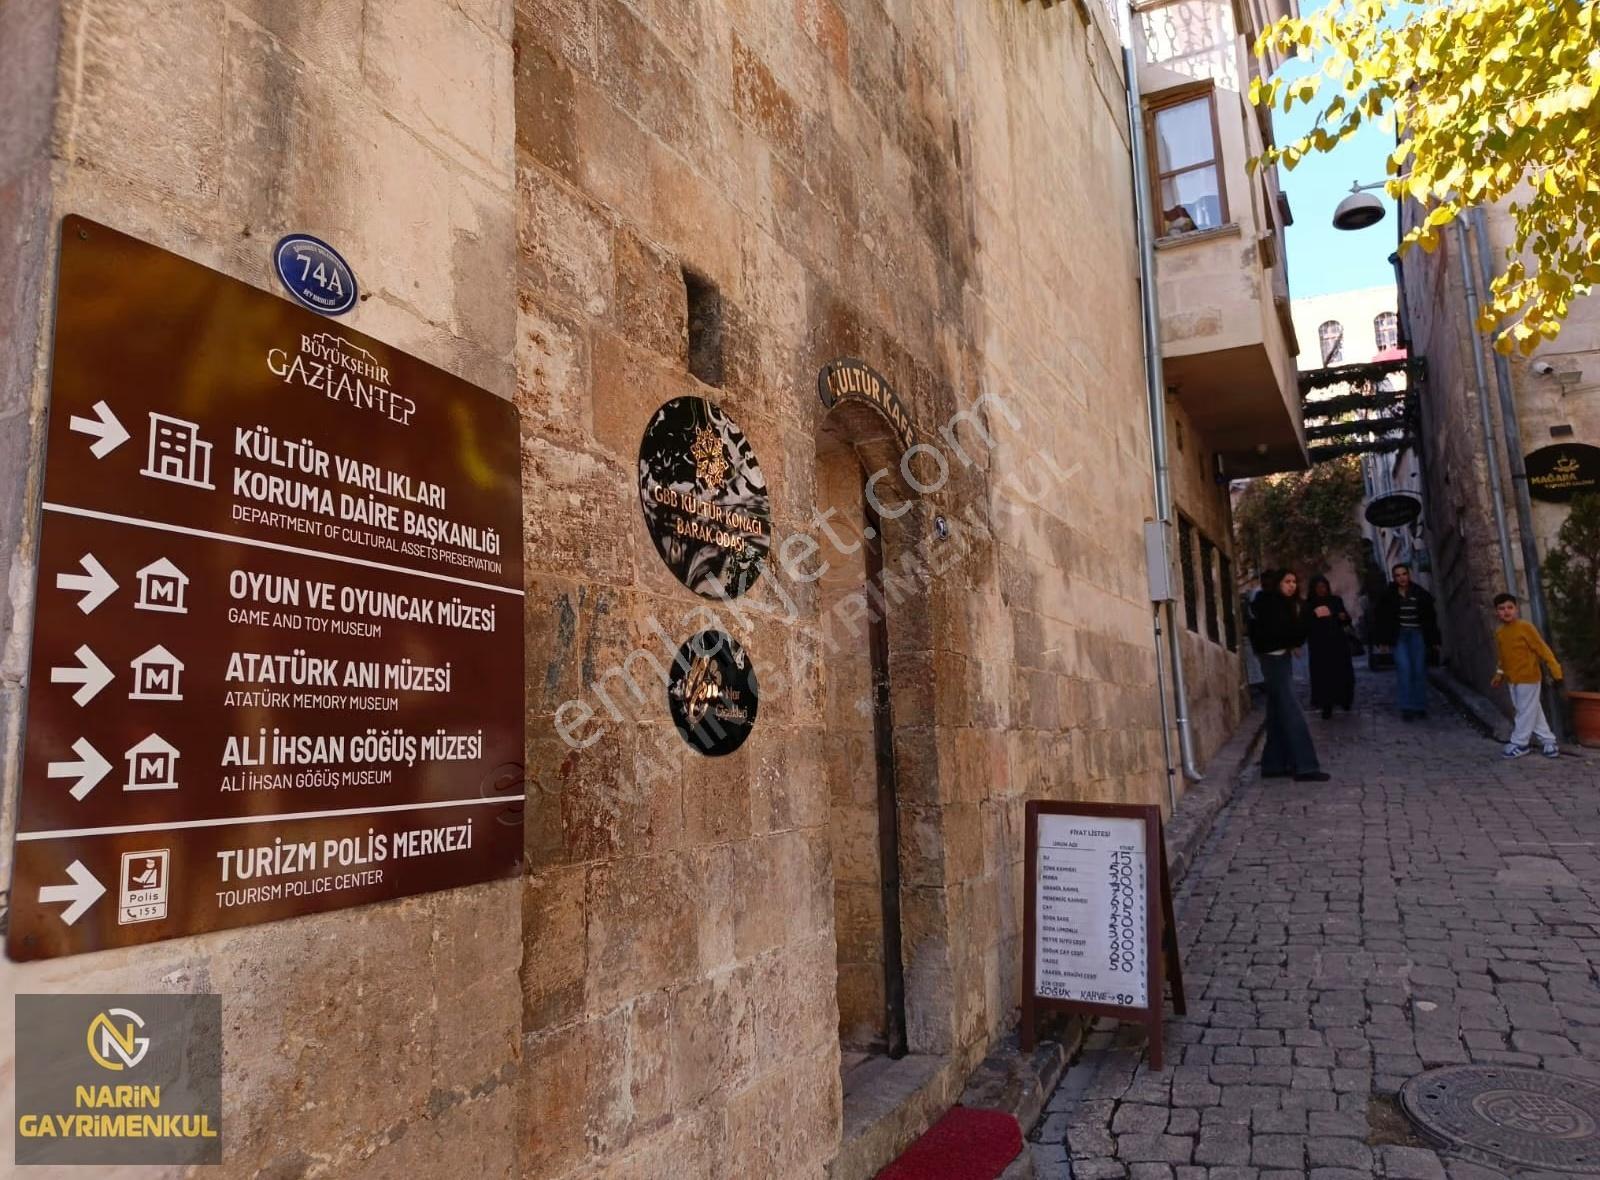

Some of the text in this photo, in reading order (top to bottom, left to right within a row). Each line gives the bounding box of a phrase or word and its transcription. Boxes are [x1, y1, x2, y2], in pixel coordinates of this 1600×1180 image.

[296, 253, 344, 297] 74A
[301, 334, 392, 386] BÜYÜKŞEHİR
[267, 348, 416, 426] GAZİANTEP
[235, 425, 446, 510] KÜLTÜR VARLIKLARI
[232, 467, 501, 556] KORUMA DAİRE BAŞKANLIĞI
[655, 485, 762, 536] GBB KÜLTÜR KONAĞI
[232, 504, 502, 575] DEPARTMENT OF CULTURAL ASSETS PRESERVATION
[677, 517, 745, 553] BARAK ODASI
[229, 569, 496, 632] OYUN VE OYUNCAK MÜZESİ
[228, 608, 382, 639] GAME AND TOY MUSEUM
[225, 648, 452, 693] ATATÜRK ANI MÜZESİ
[224, 689, 399, 712] ATATÜRK MEMORY MUSEUM
[221, 727, 483, 768] ALİ İHSAN GÖĞÜŞ MÜZESİ
[220, 769, 392, 793] ALİ İHSAN GÖĞÜŞ MUSEUM
[217, 817, 473, 882] TURİZM POLİS MERKEZİ
[130, 893, 159, 903] Polis
[140, 906, 157, 916] 155
[216, 870, 383, 908] TOURISM POLICE CENTER
